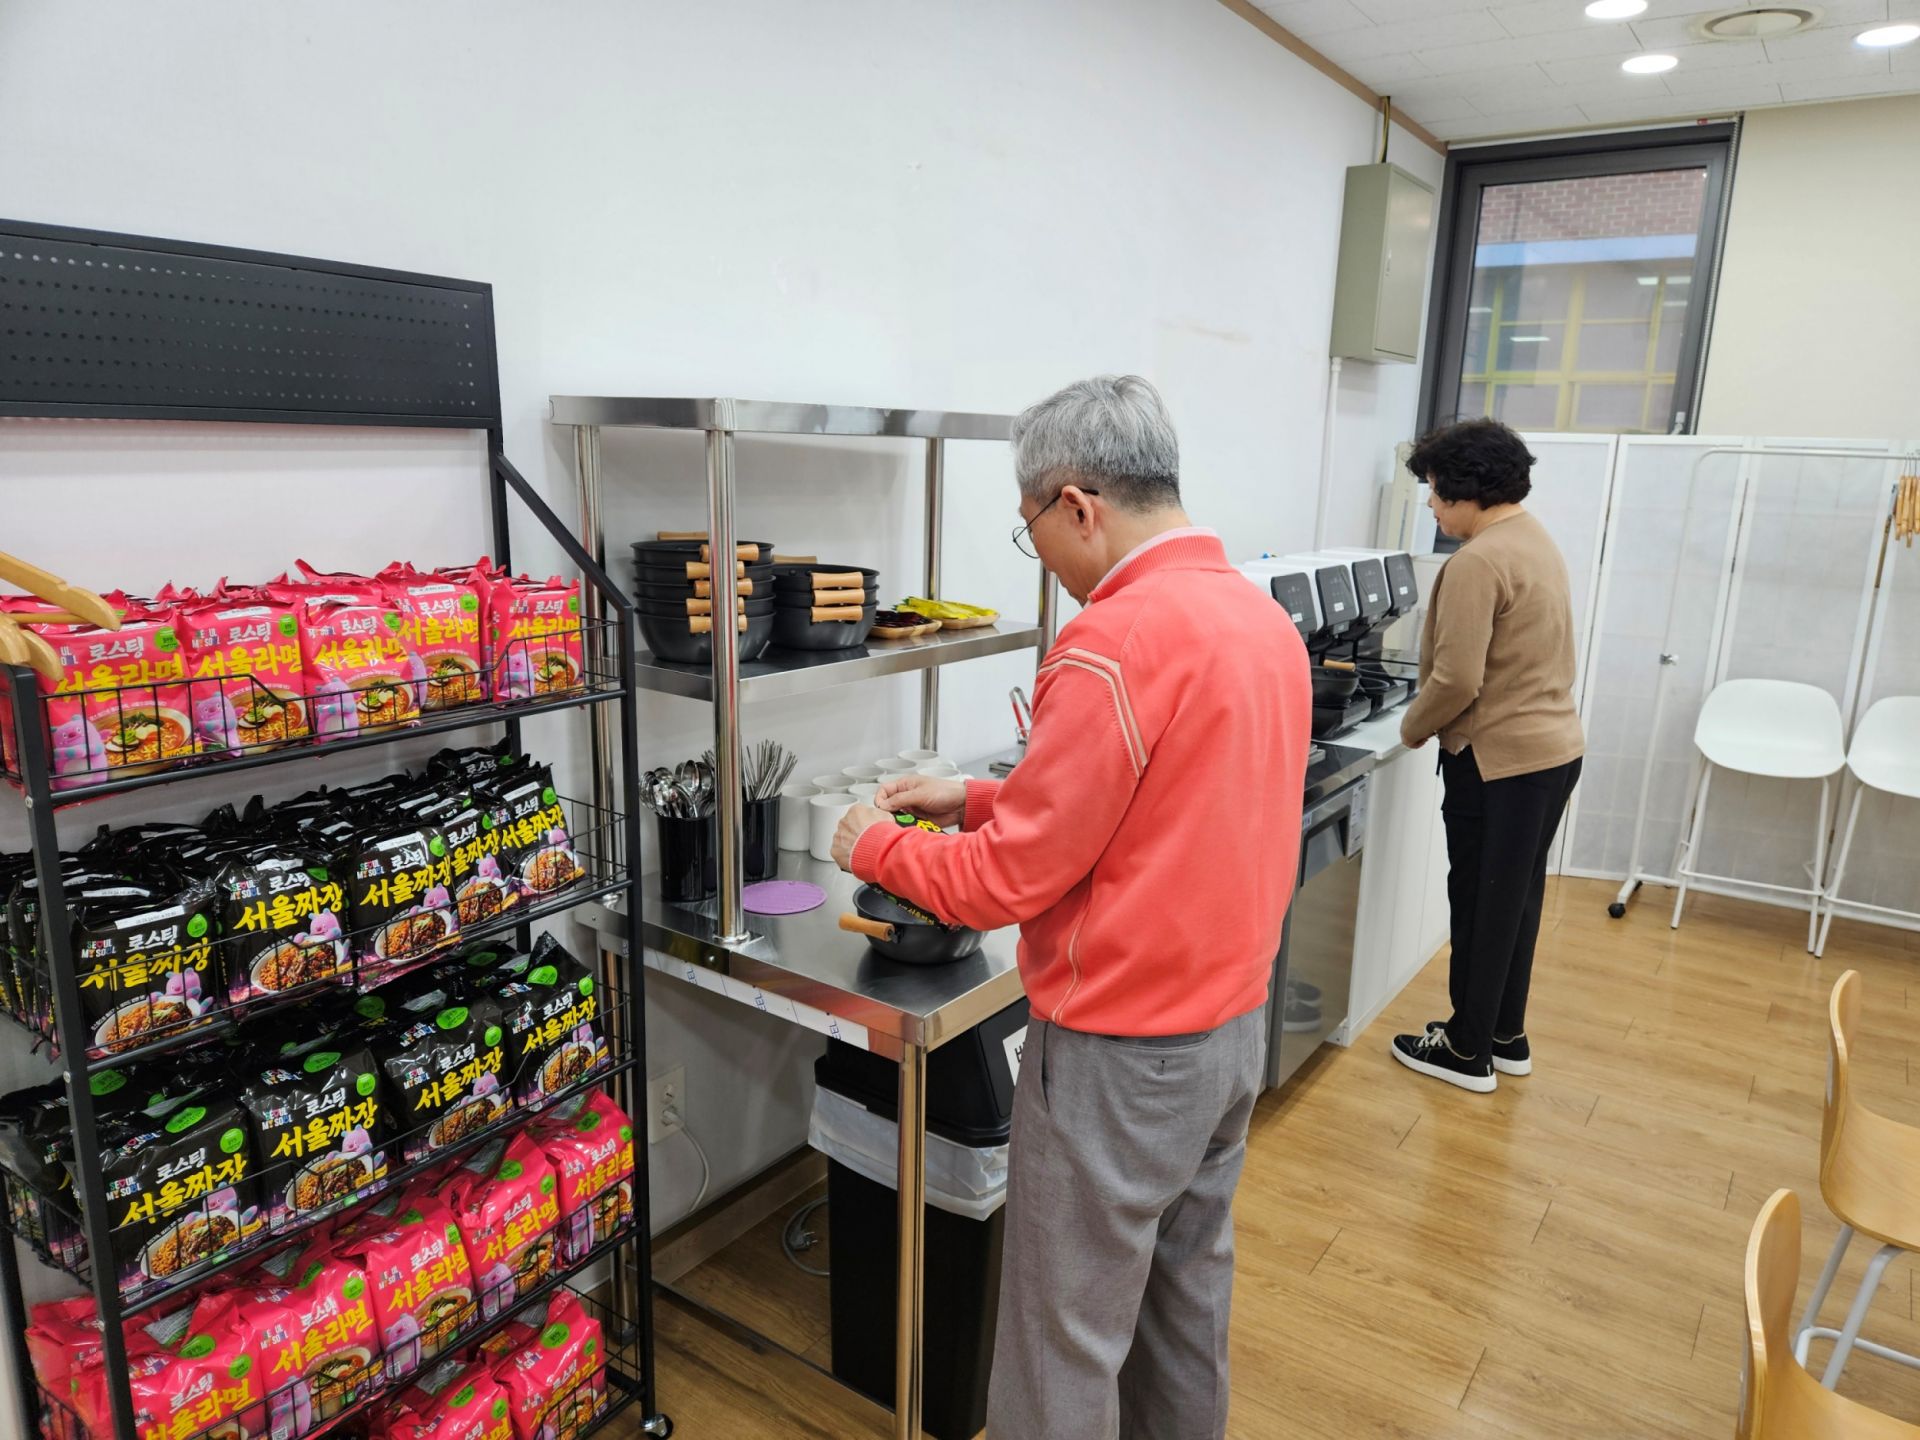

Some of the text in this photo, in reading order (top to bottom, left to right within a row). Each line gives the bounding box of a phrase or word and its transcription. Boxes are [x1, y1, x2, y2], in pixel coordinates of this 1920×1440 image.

[533, 599, 564, 615] 로스팅
[227, 622, 271, 645] 로스팅
[340, 616, 378, 637] 로스팅
[397, 614, 479, 647] 서울라면
[506, 615, 582, 645] 서울라면
[88, 637, 144, 664] 로스팅
[193, 640, 303, 684] 서울라면
[55, 653, 185, 704] 서울라면
[514, 796, 539, 819] 로스팅
[447, 822, 477, 849] 로스팅
[501, 804, 565, 849] 서울짜장
[450, 828, 500, 877] 울짜장
[268, 872, 311, 895] 로스팅
[360, 854, 451, 908] 서울짜장
[232, 881, 343, 931] 서울짜장
[125, 924, 179, 954] 로스팅
[79, 937, 212, 991] 서울짜장
[543, 992, 573, 1020] 로스팅
[521, 996, 597, 1055] 서울짜장
[439, 1043, 476, 1075] 로스팅
[413, 1046, 504, 1112] 서울짜장
[305, 1087, 346, 1119] 로스팅
[270, 1096, 378, 1158] 서울짜장
[155, 1148, 207, 1184] 로스팅
[572, 1141, 635, 1199] 서울라면
[591, 1137, 616, 1166] 로스팅
[120, 1152, 247, 1224] 서울짜장
[481, 1193, 560, 1263] 서울라면
[503, 1192, 533, 1228] 로스팅
[410, 1238, 444, 1273] 로스팅
[386, 1243, 470, 1313] 서울라면
[301, 1294, 338, 1333] 로스팅
[270, 1299, 374, 1375] 서울라면
[168, 1372, 213, 1414] 로스팅
